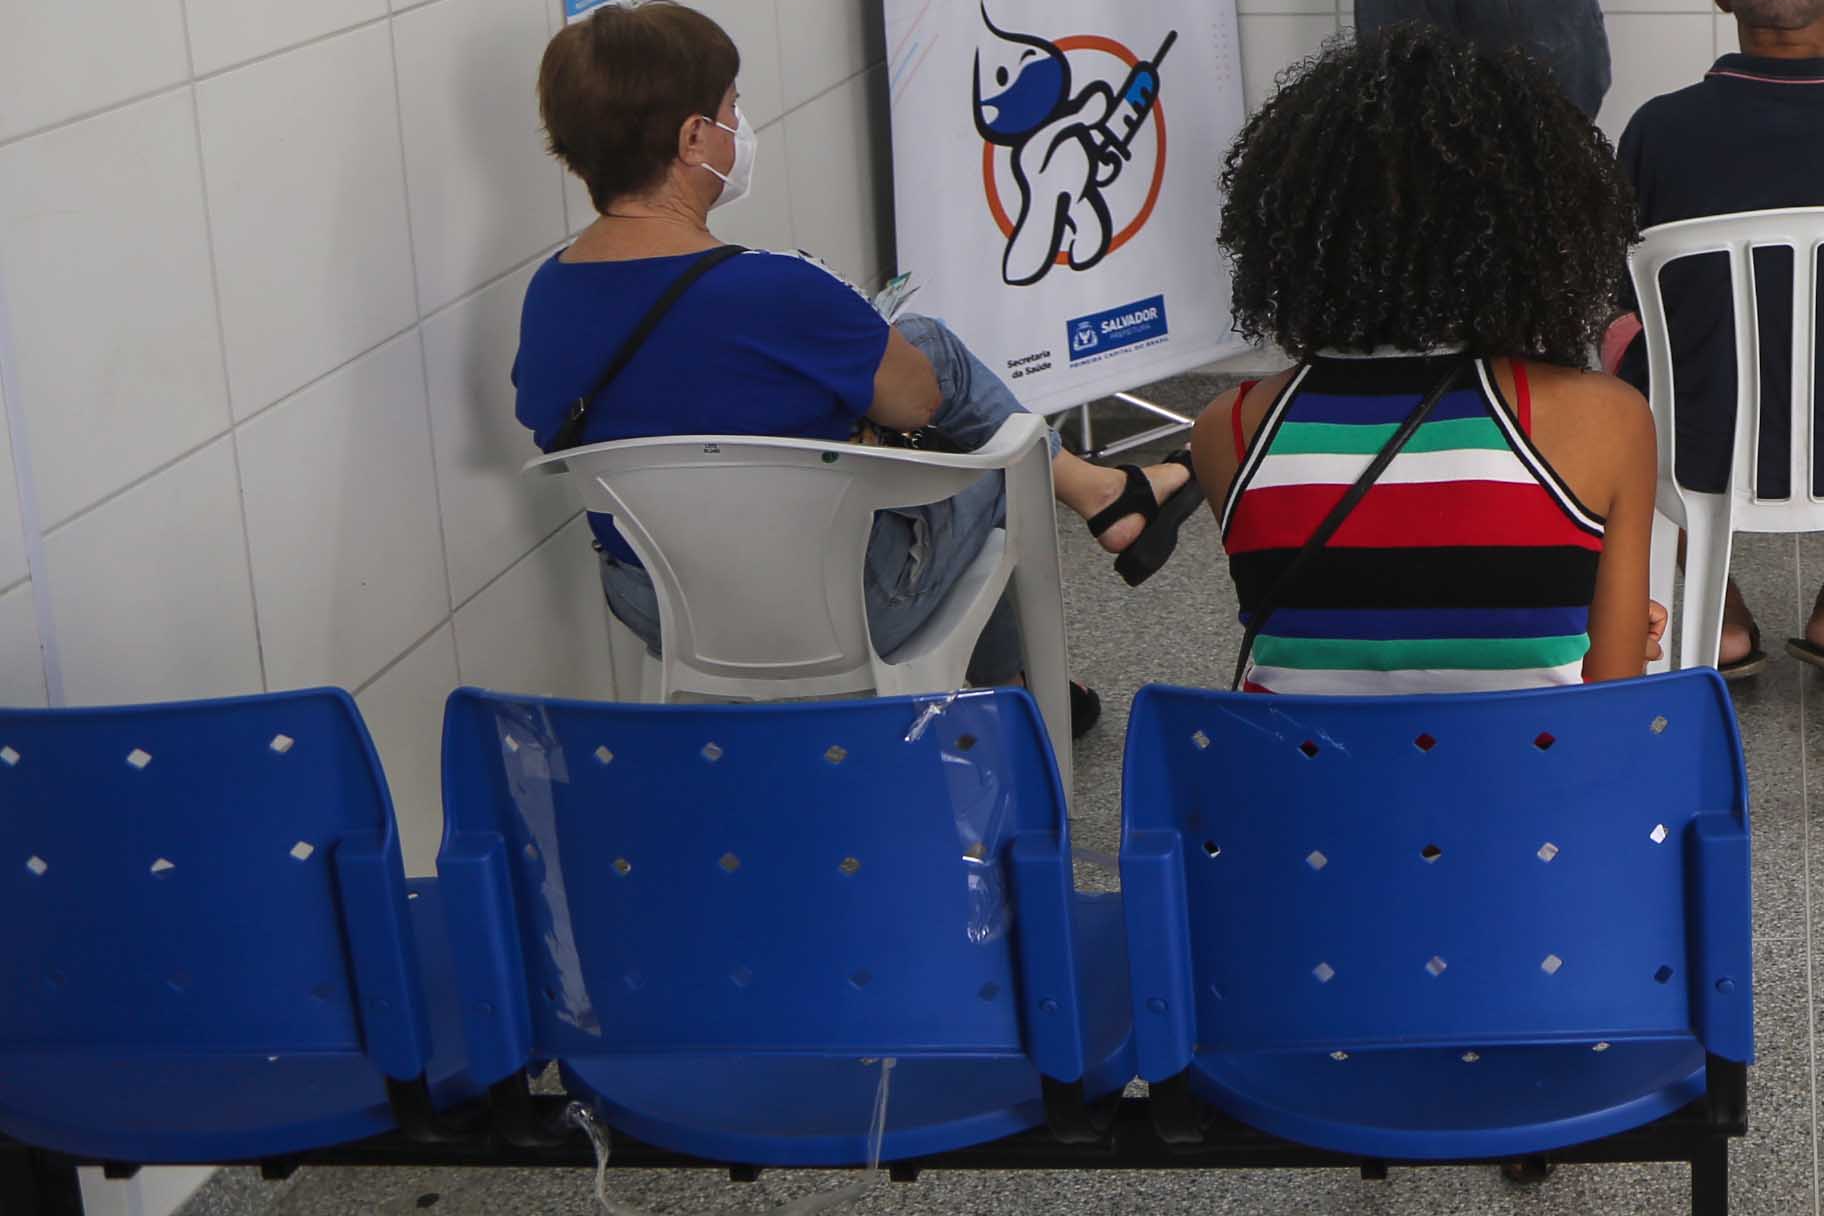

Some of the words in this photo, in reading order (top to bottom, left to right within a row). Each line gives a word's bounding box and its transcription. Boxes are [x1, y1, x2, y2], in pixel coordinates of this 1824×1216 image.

[1101, 307, 1158, 334] SALVADOR
[1007, 350, 1051, 369] Secretaria
[1012, 369, 1023, 379] da
[1025, 361, 1052, 376] Saúde
